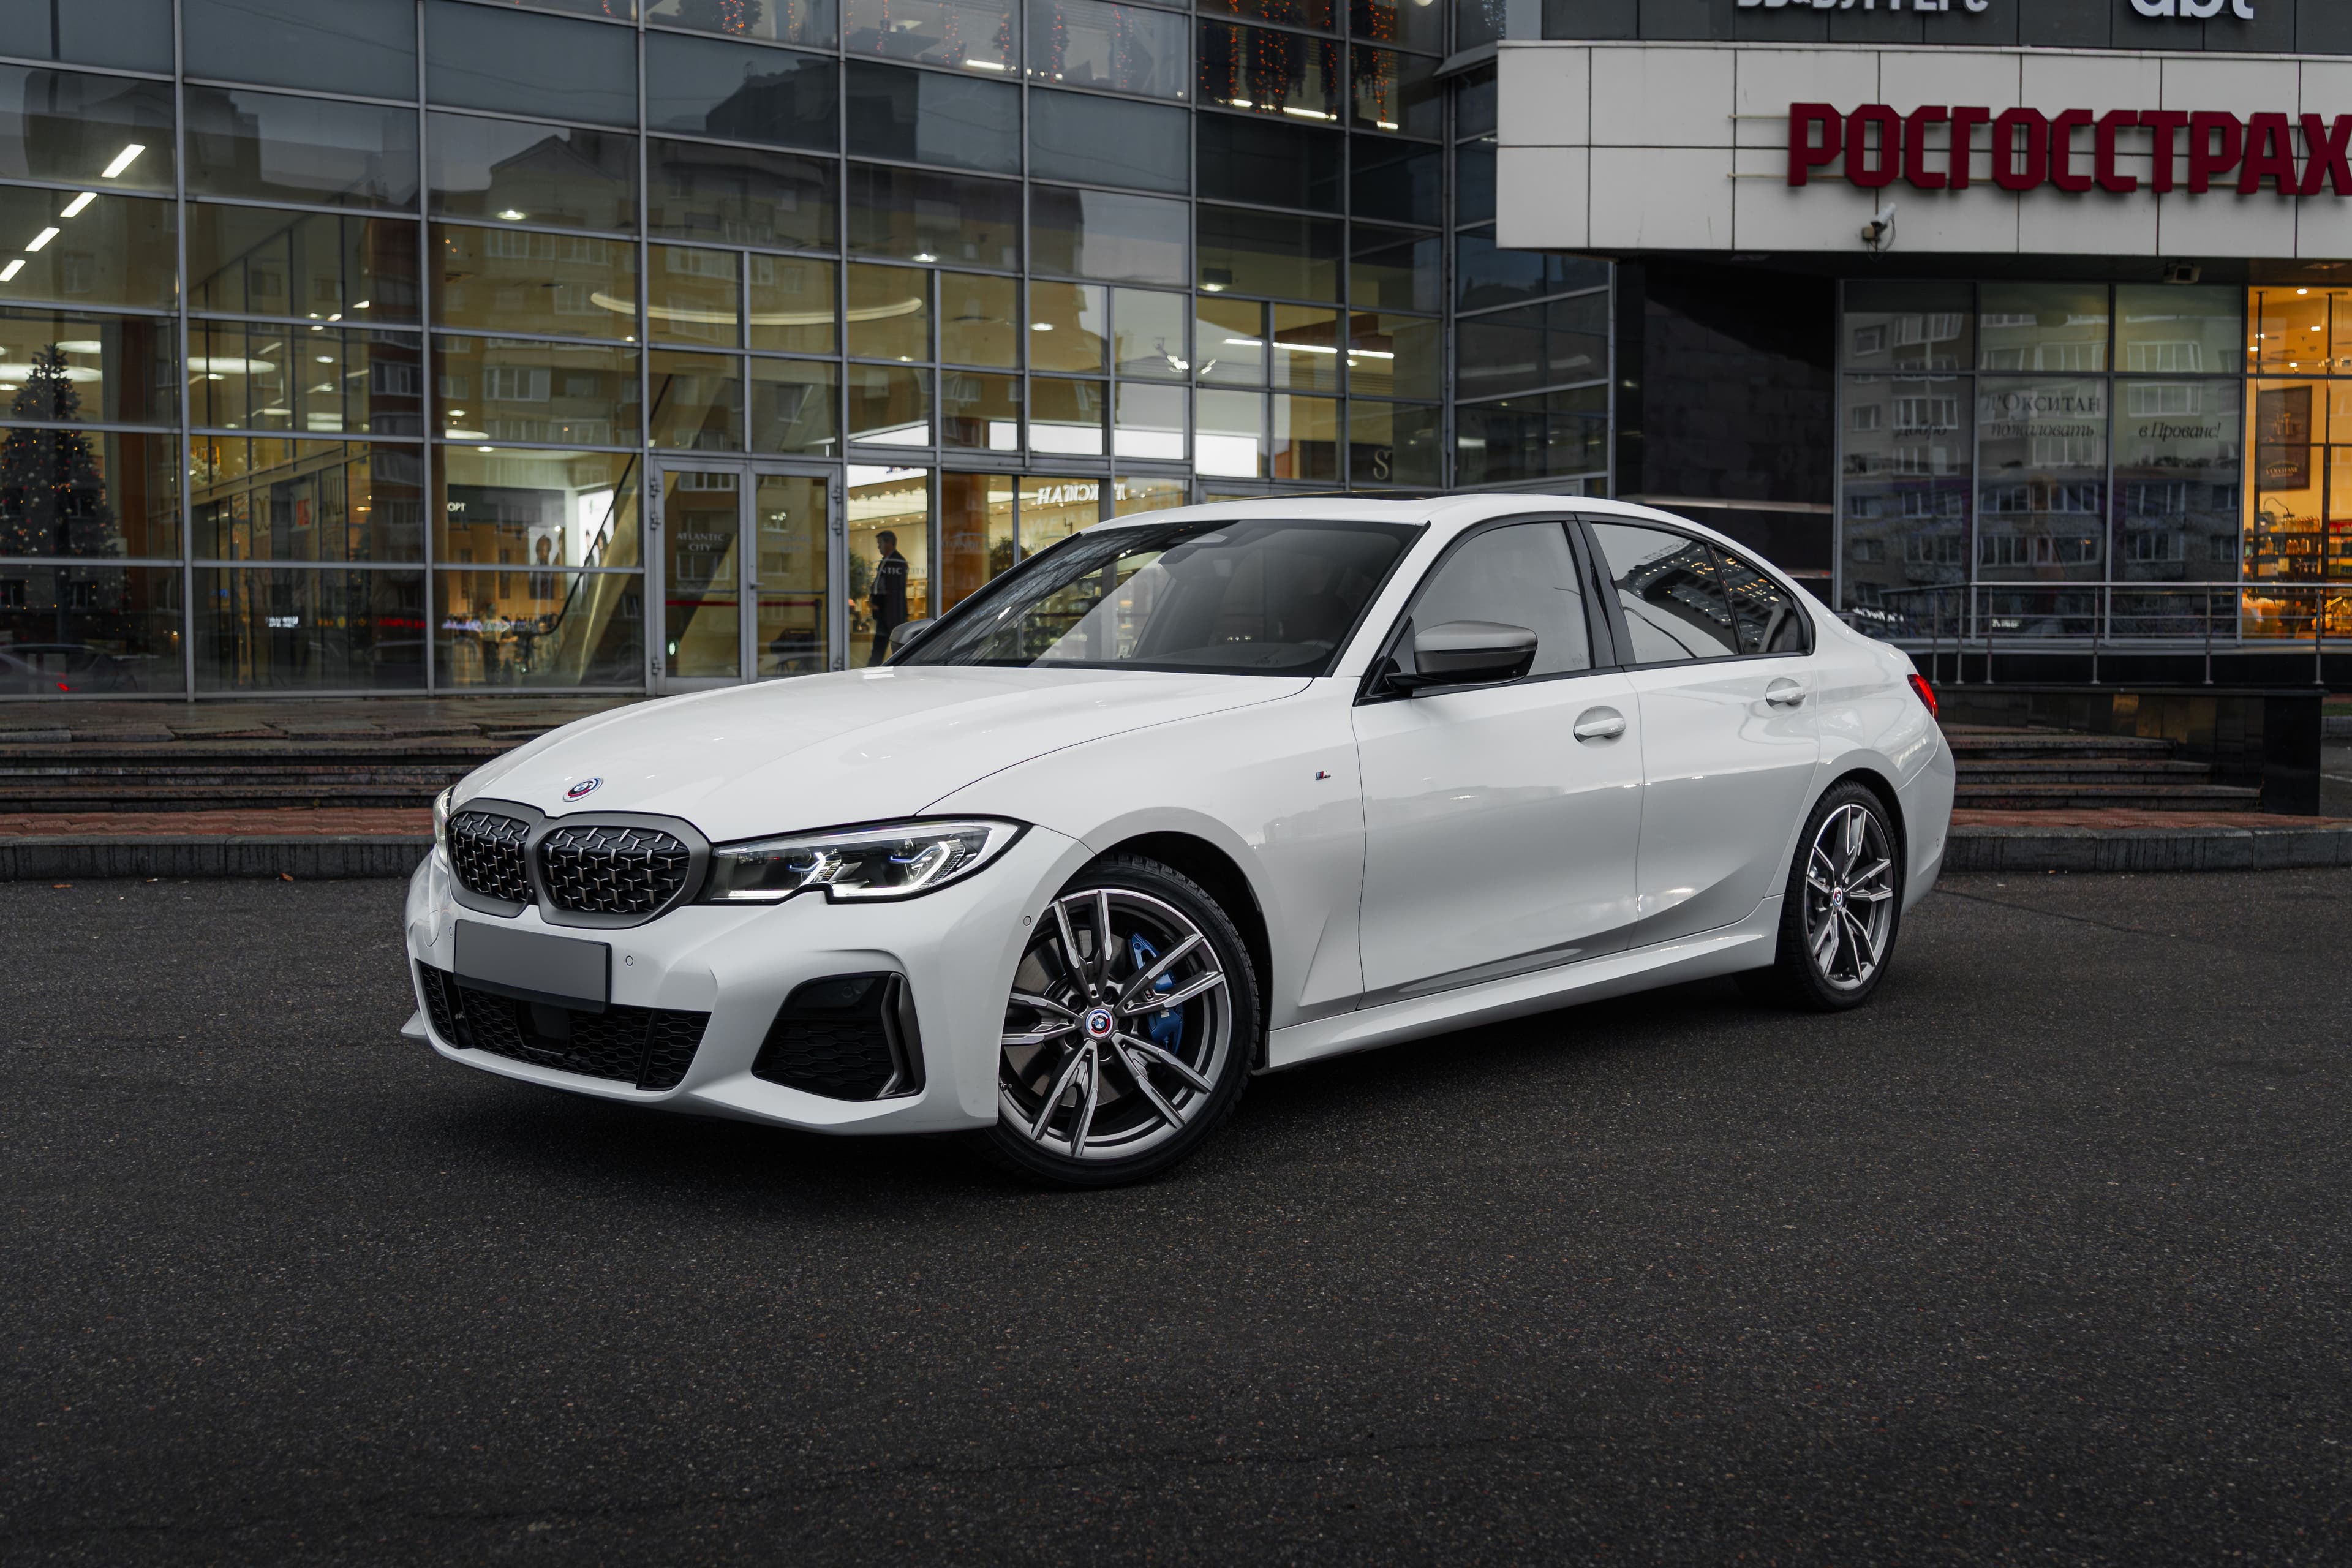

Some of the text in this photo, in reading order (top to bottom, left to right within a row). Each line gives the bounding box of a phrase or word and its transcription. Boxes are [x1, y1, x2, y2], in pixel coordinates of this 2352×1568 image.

[1788, 102, 2352, 196] РОСГОССТРАХ
[2139, 424, 2148, 437] в
[2150, 421, 2221, 442] Прованс!
[676, 533, 725, 541] ATLANTIC
